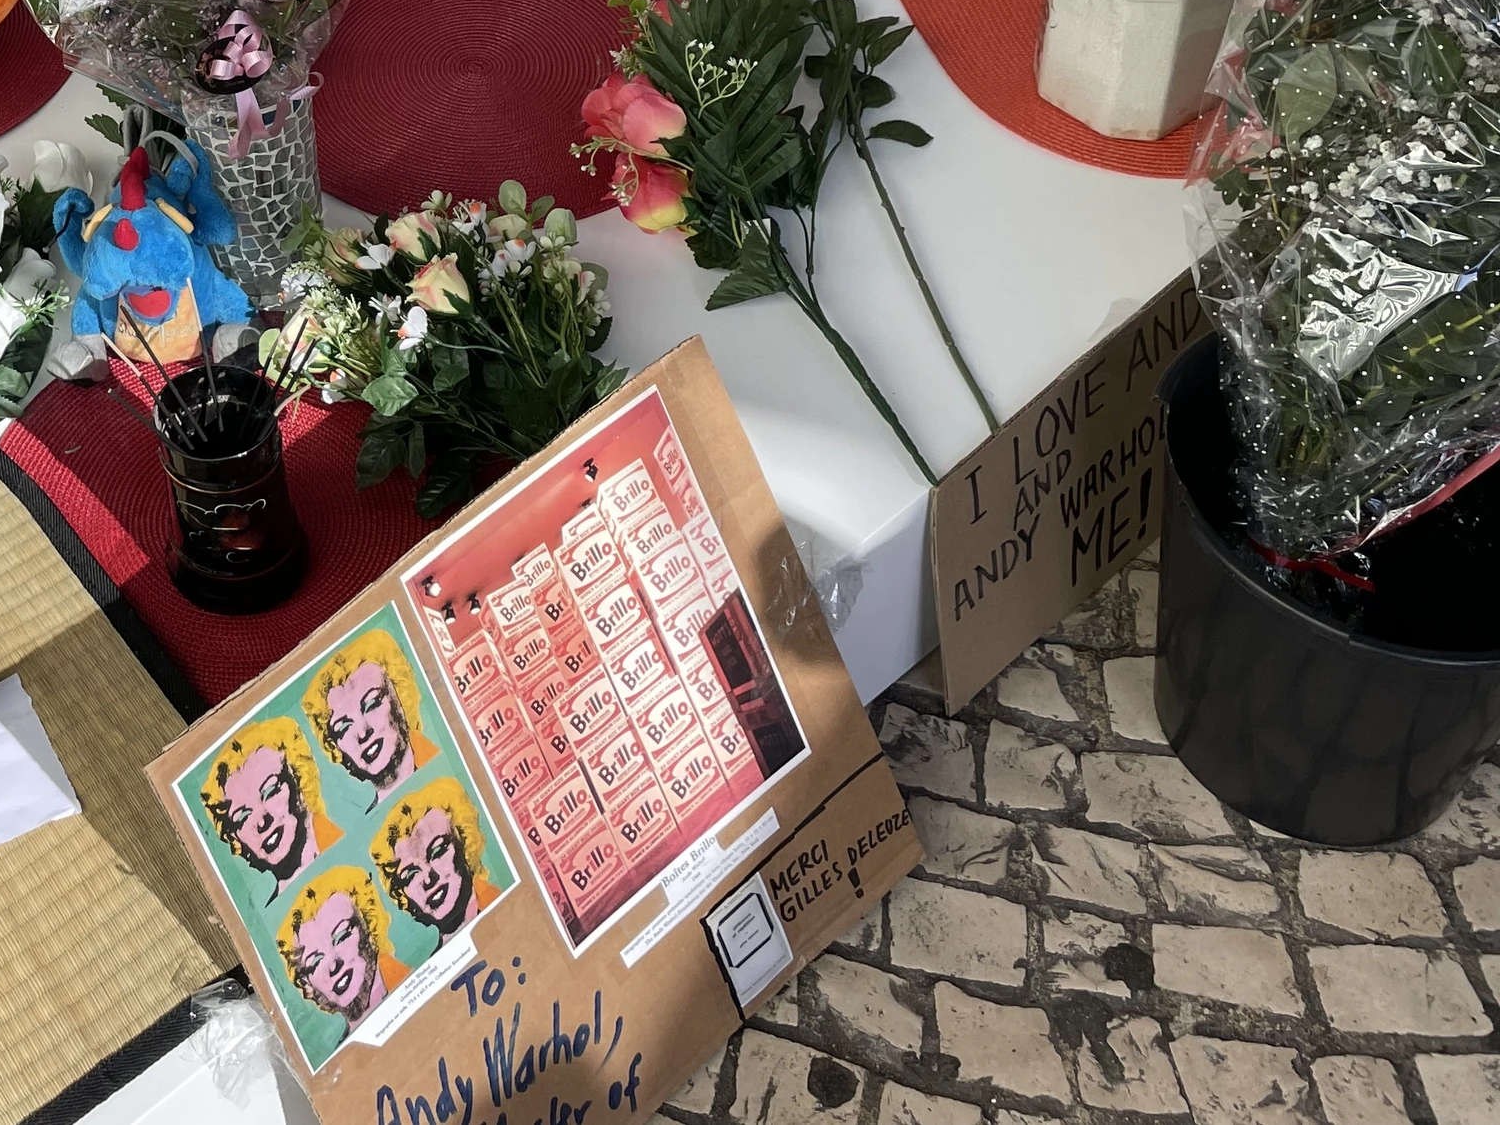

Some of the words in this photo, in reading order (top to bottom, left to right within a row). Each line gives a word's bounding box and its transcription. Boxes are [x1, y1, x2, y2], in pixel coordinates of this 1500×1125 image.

[964, 464, 987, 525] I
[1012, 357, 1106, 485] LOVE
[1125, 286, 1203, 393] AND
[613, 478, 650, 512] Brillo
[954, 512, 1041, 623] ANDY
[1059, 403, 1166, 529] WARHOL
[1013, 448, 1072, 531] AND
[636, 521, 673, 555] Brillo
[1071, 466, 1154, 588] ME!
[570, 541, 613, 583] Brillo
[649, 554, 692, 594] Brillo
[500, 594, 532, 623] Brillo
[596, 595, 637, 638] Brillo
[513, 637, 547, 671] Brillo
[621, 649, 662, 691] Brillo
[531, 680, 565, 717] Brillo
[569, 689, 613, 735] Brillo
[646, 700, 689, 745] Brillo
[501, 755, 541, 799] Brillo
[597, 740, 642, 787] Brillo
[670, 754, 713, 800] Brillo
[544, 788, 588, 836] Brillo
[621, 797, 664, 845] Brillo
[570, 842, 614, 892] Brillo
[661, 858, 690, 889] Boîtes
[689, 836, 717, 863] Brillo
[770, 839, 828, 900] MERCI
[779, 861, 843, 923] GILLES
[847, 808, 909, 866] DELEUZE
[450, 956, 527, 1018] To:
[376, 1056, 473, 1125] Andy
[608, 1051, 642, 1113] of
